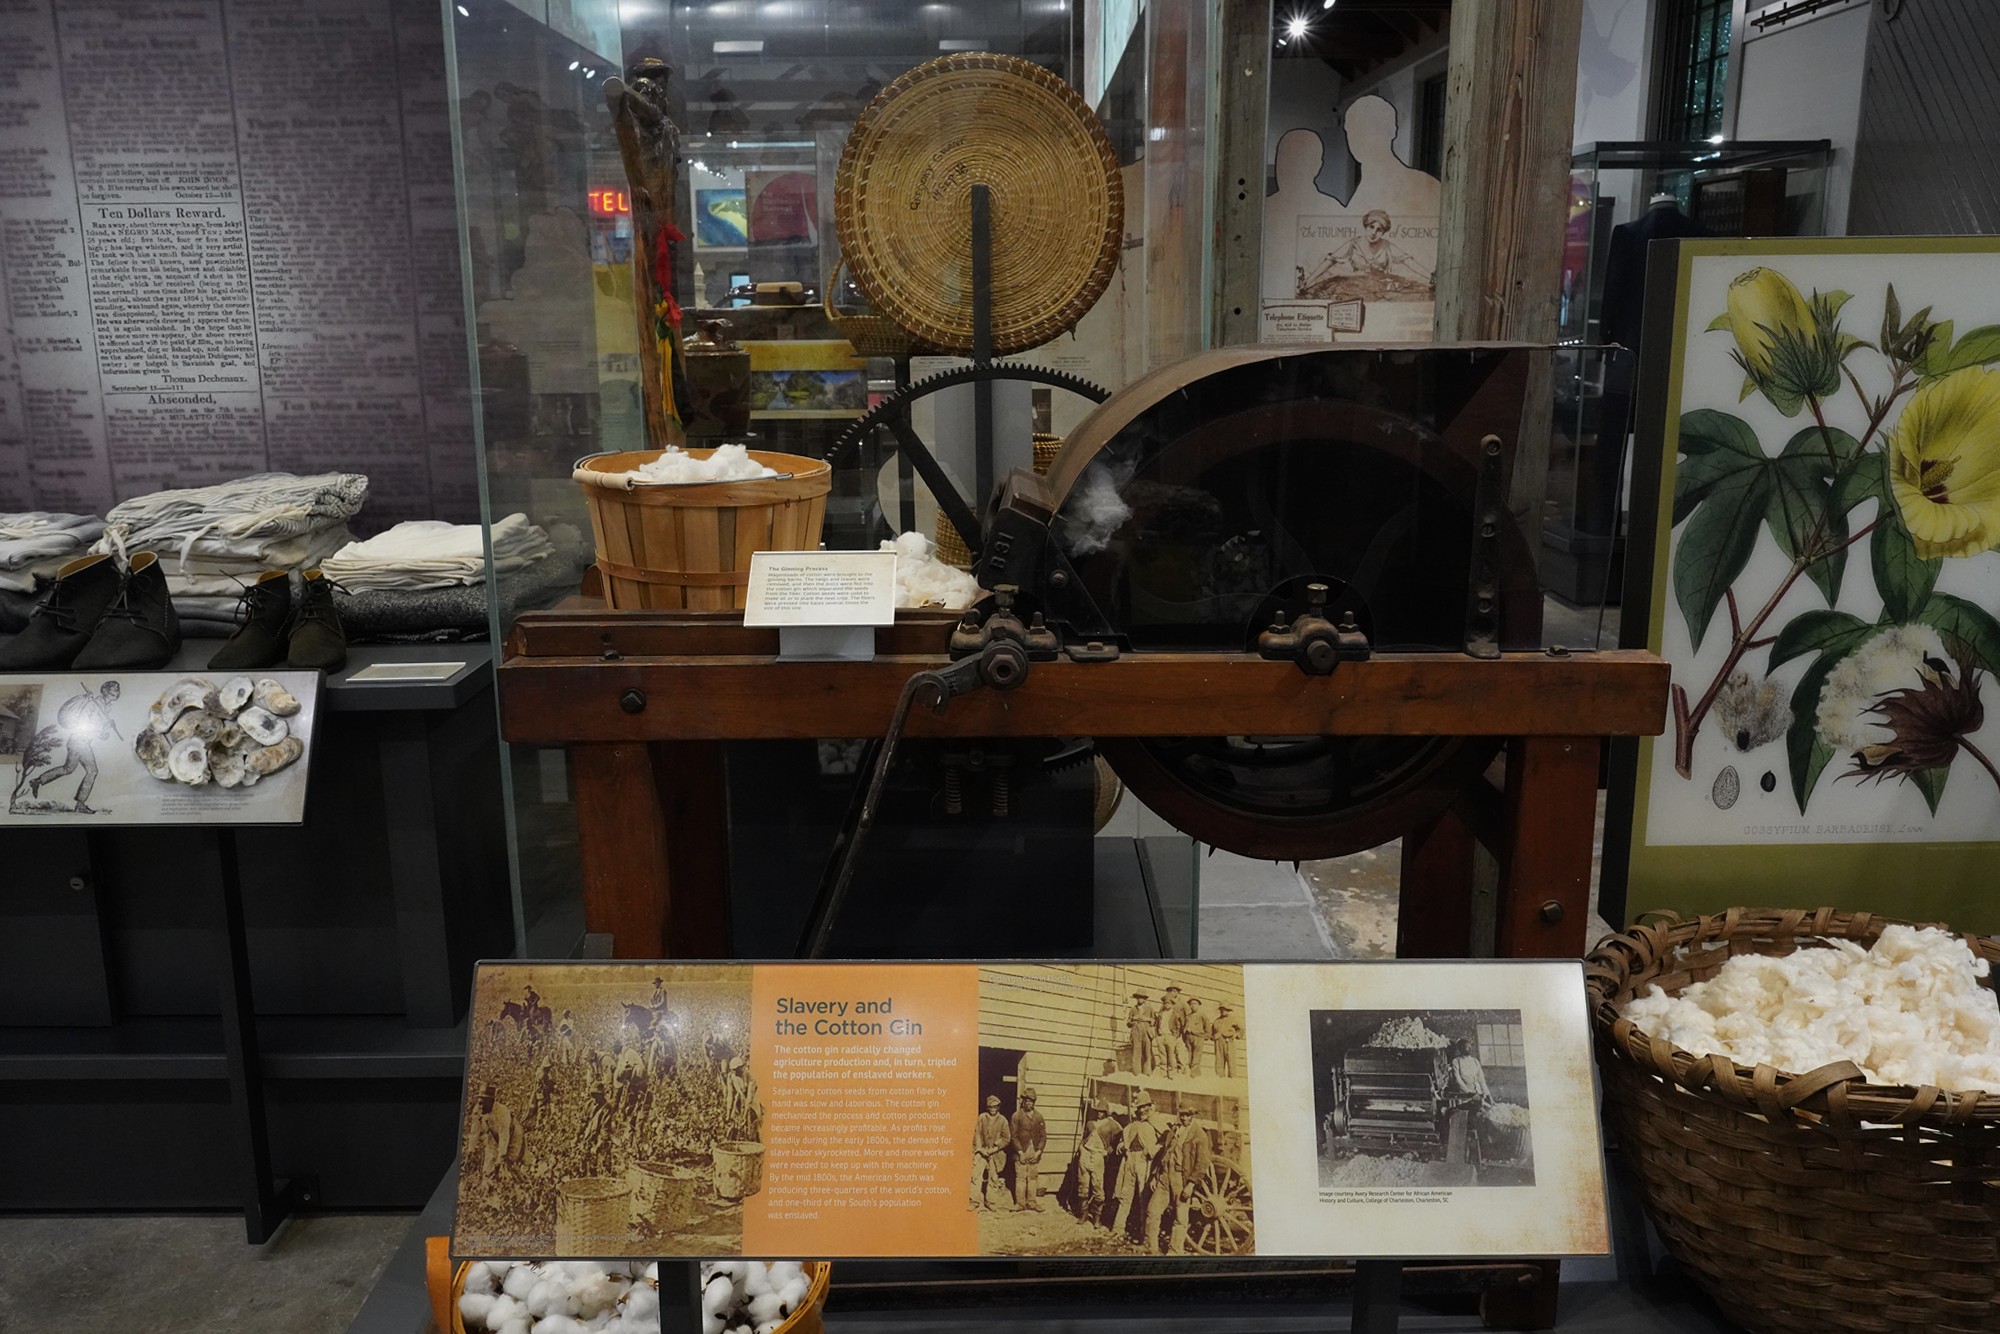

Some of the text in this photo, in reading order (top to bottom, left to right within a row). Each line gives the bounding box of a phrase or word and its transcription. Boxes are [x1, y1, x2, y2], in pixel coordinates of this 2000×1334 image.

[588, 192, 628, 211] TEL
[98, 207, 225, 219] Ten Dollars Reward.
[1302, 225, 1440, 239] The TRIUMPH of SCIENC
[1264, 313, 1295, 322] Telephone
[1297, 313, 1324, 322] Etiquette
[161, 375, 196, 383] Thomas
[148, 394, 217, 405] Absconded,
[1744, 825, 1810, 835] GOSSYPIUM
[776, 997, 891, 1017] Slavery and
[775, 1019, 922, 1035] the Cotton Gin
[774, 1045, 921, 1056] The cotton gin radically changed
[773, 1057, 956, 1068] agriculture production and, in turn, tripled
[773, 1070, 934, 1081] the population of enslaved workers.
[772, 1086, 815, 1097] Separating
[843, 1087, 866, 1095] seeds
[867, 1087, 887, 1095] from
[916, 1087, 935, 1095] fiber
[937, 1087, 947, 1097] by
[828, 1100, 843, 1108] and
[844, 1099, 883, 1108] laborious.
[884, 1099, 900, 1107] The
[927, 1099, 939, 1109] gin
[771, 1111, 951, 1121] mechanized the process and cotton production
[771, 1124, 801, 1132] became
[802, 1124, 849, 1134] increasingly
[849, 1123, 888, 1133] profitable.
[890, 1123, 901, 1132] As
[902, 1123, 927, 1133] profits
[770, 1135, 952, 1146] steadily during the early 1800s, the demand for
[770, 1148, 954, 1159] slave labor skyrocketed. More and more workers
[790, 1161, 819, 1169] needed
[830, 1161, 849, 1170] keep
[850, 1162, 861, 1170] up
[862, 1161, 880, 1169] with
[881, 1161, 894, 1169] the
[896, 1161, 938, 1171] machinery.
[769, 1172, 780, 1184] By
[796, 1174, 811, 1182] mid
[813, 1173, 838, 1182] 1800s,
[840, 1173, 853, 1181] the
[854, 1173, 892, 1181] American
[894, 1173, 917, 1182] South
[768, 1185, 951, 1196] producing three-quarters of the world's cotton,
[768, 1198, 921, 1208] and one-third of the South's population
[784, 1211, 820, 1219] enslaved.
